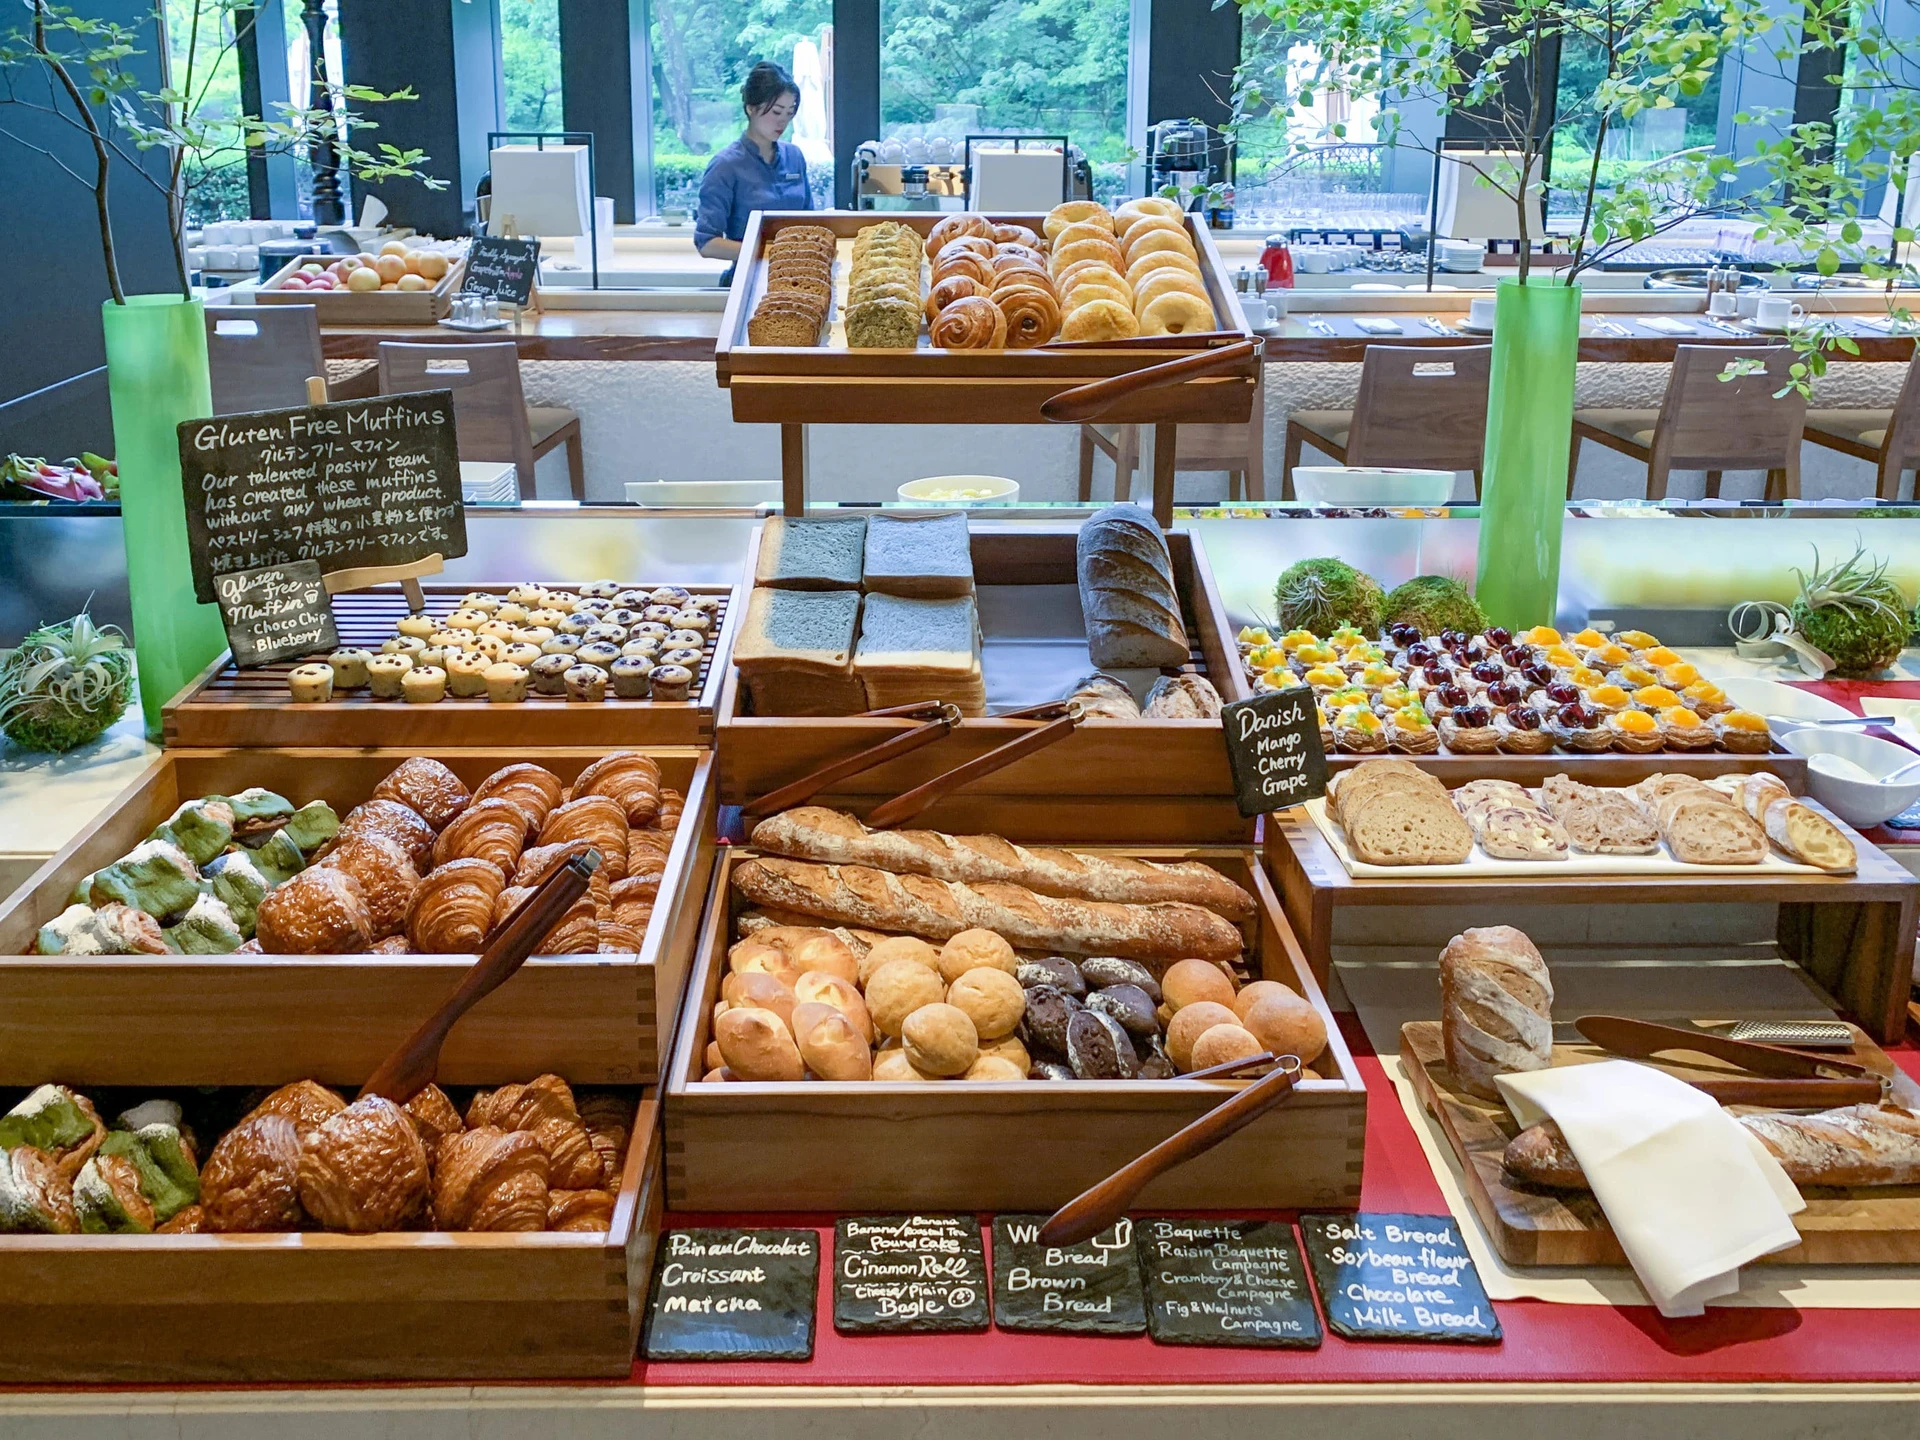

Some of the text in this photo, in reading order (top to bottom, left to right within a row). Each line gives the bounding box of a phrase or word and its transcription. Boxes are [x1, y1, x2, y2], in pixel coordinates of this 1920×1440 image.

[465, 276, 517, 297] Ginger Juice
[194, 405, 445, 450] Gluten Free Muffins
[202, 454, 430, 491] Our talented pastry team
[205, 468, 438, 513] has created these muffins
[206, 485, 446, 529] without any wheat product.
[262, 581, 302, 600] free
[227, 596, 304, 625] Muffin
[254, 612, 327, 634] Choco Chip
[256, 628, 322, 652] Blueberry
[1236, 701, 1306, 741] Danish
[1257, 733, 1301, 755] Mango
[1258, 751, 1307, 775] Cherry
[1262, 774, 1308, 796] Grape
[912, 1216, 960, 1226] Banana
[946, 1227, 968, 1237] Tea
[669, 1234, 811, 1257] Pain au Chocolat
[870, 1236, 960, 1252] Pound Cake
[1325, 1223, 1457, 1246] Salt Bread
[1045, 1248, 1109, 1267] Bread
[1157, 1241, 1213, 1257] Raisin
[1330, 1247, 1471, 1270] Soybean flour
[661, 1263, 766, 1287] Croissant
[844, 1255, 970, 1278] Cinamon Roll
[1212, 1258, 1290, 1274] Campagne
[1008, 1267, 1086, 1291] Brown
[1245, 1274, 1298, 1289] Cheese
[1392, 1268, 1462, 1287] Bread
[1043, 1292, 1111, 1313] Bread
[1217, 1287, 1294, 1305] Campagne
[1346, 1283, 1454, 1304] Chocolate
[875, 1297, 944, 1318] Bagle
[1165, 1301, 1263, 1317] Fig & Walnuts
[1353, 1305, 1487, 1329] Milk Bread
[1221, 1316, 1302, 1335] Campagne
